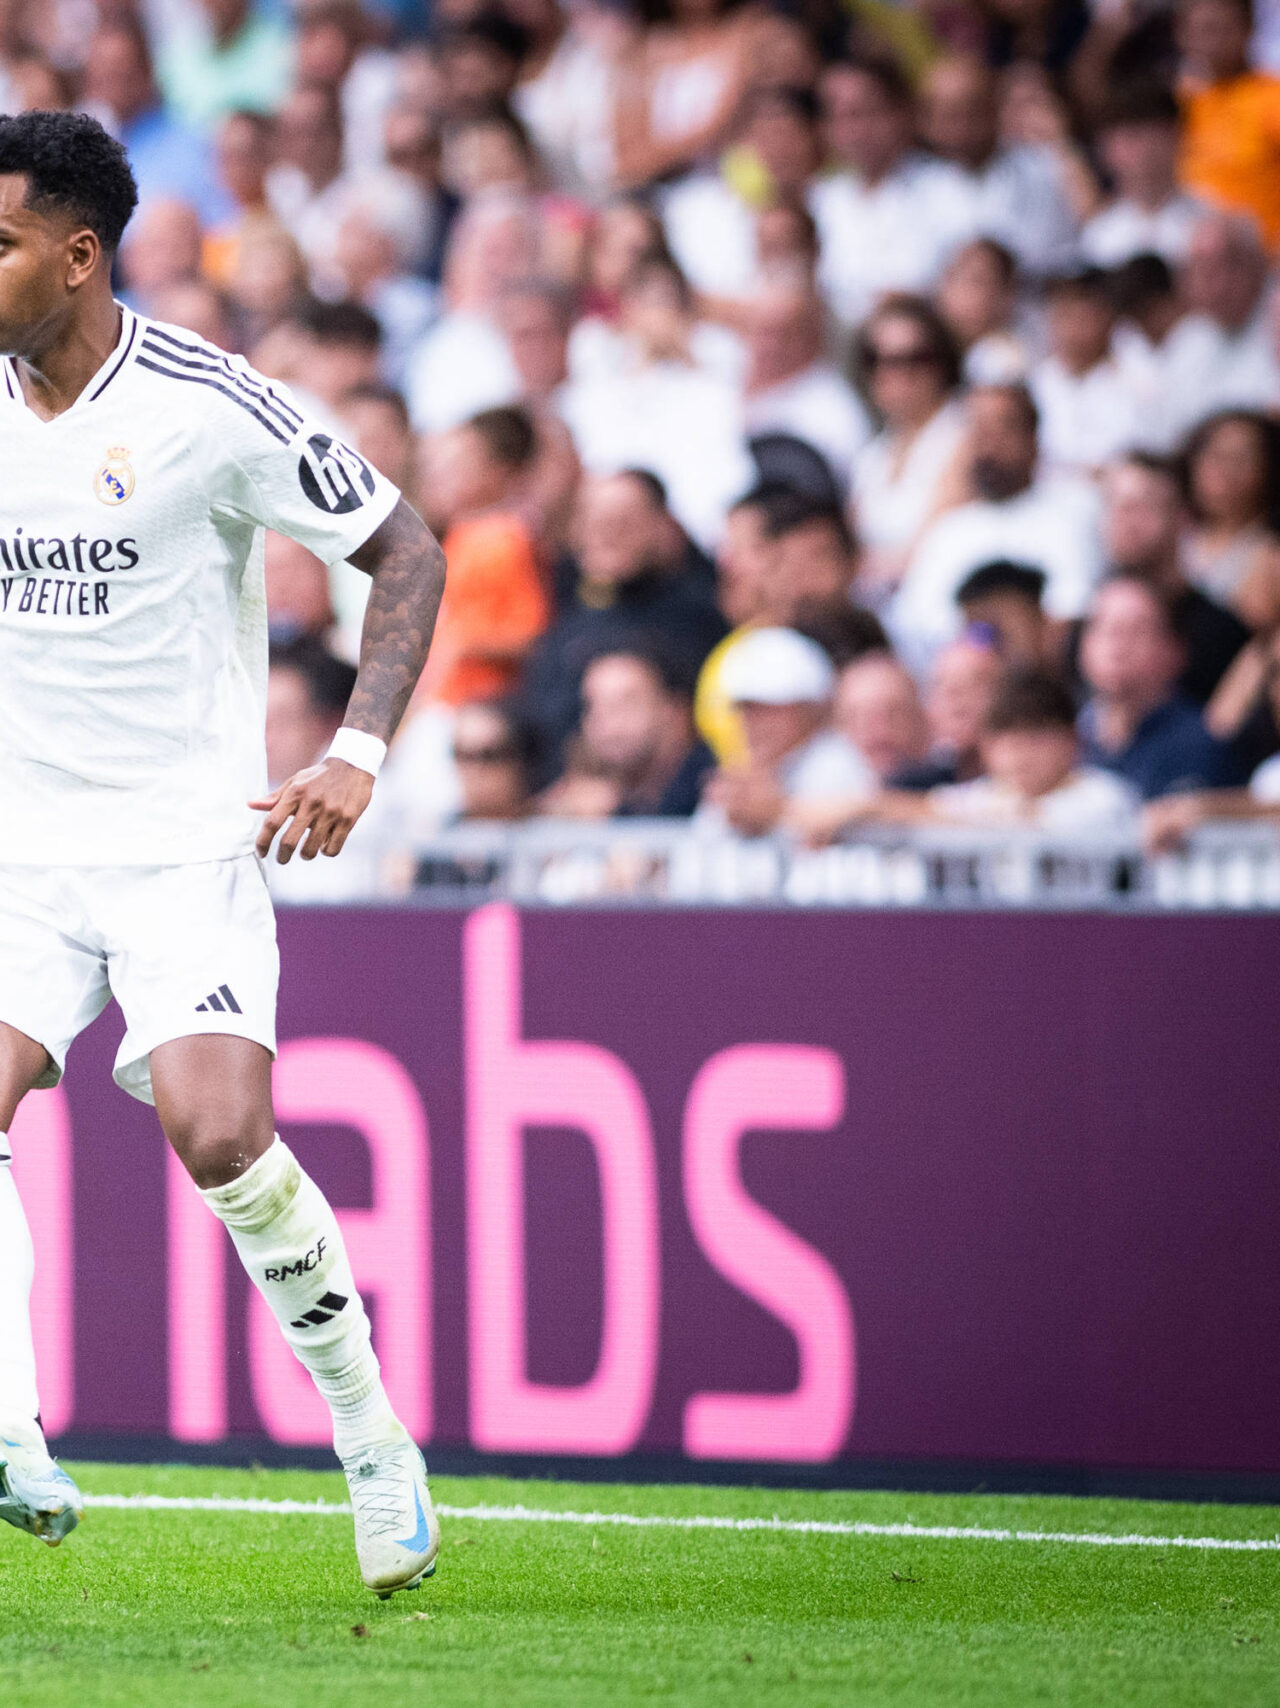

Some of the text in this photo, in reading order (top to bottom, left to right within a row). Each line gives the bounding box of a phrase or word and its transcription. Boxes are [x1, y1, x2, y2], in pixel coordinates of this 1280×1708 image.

[298, 433, 376, 514] hp
[18, 577, 110, 615] BETTER
[264, 1236, 326, 1282] RMCF
